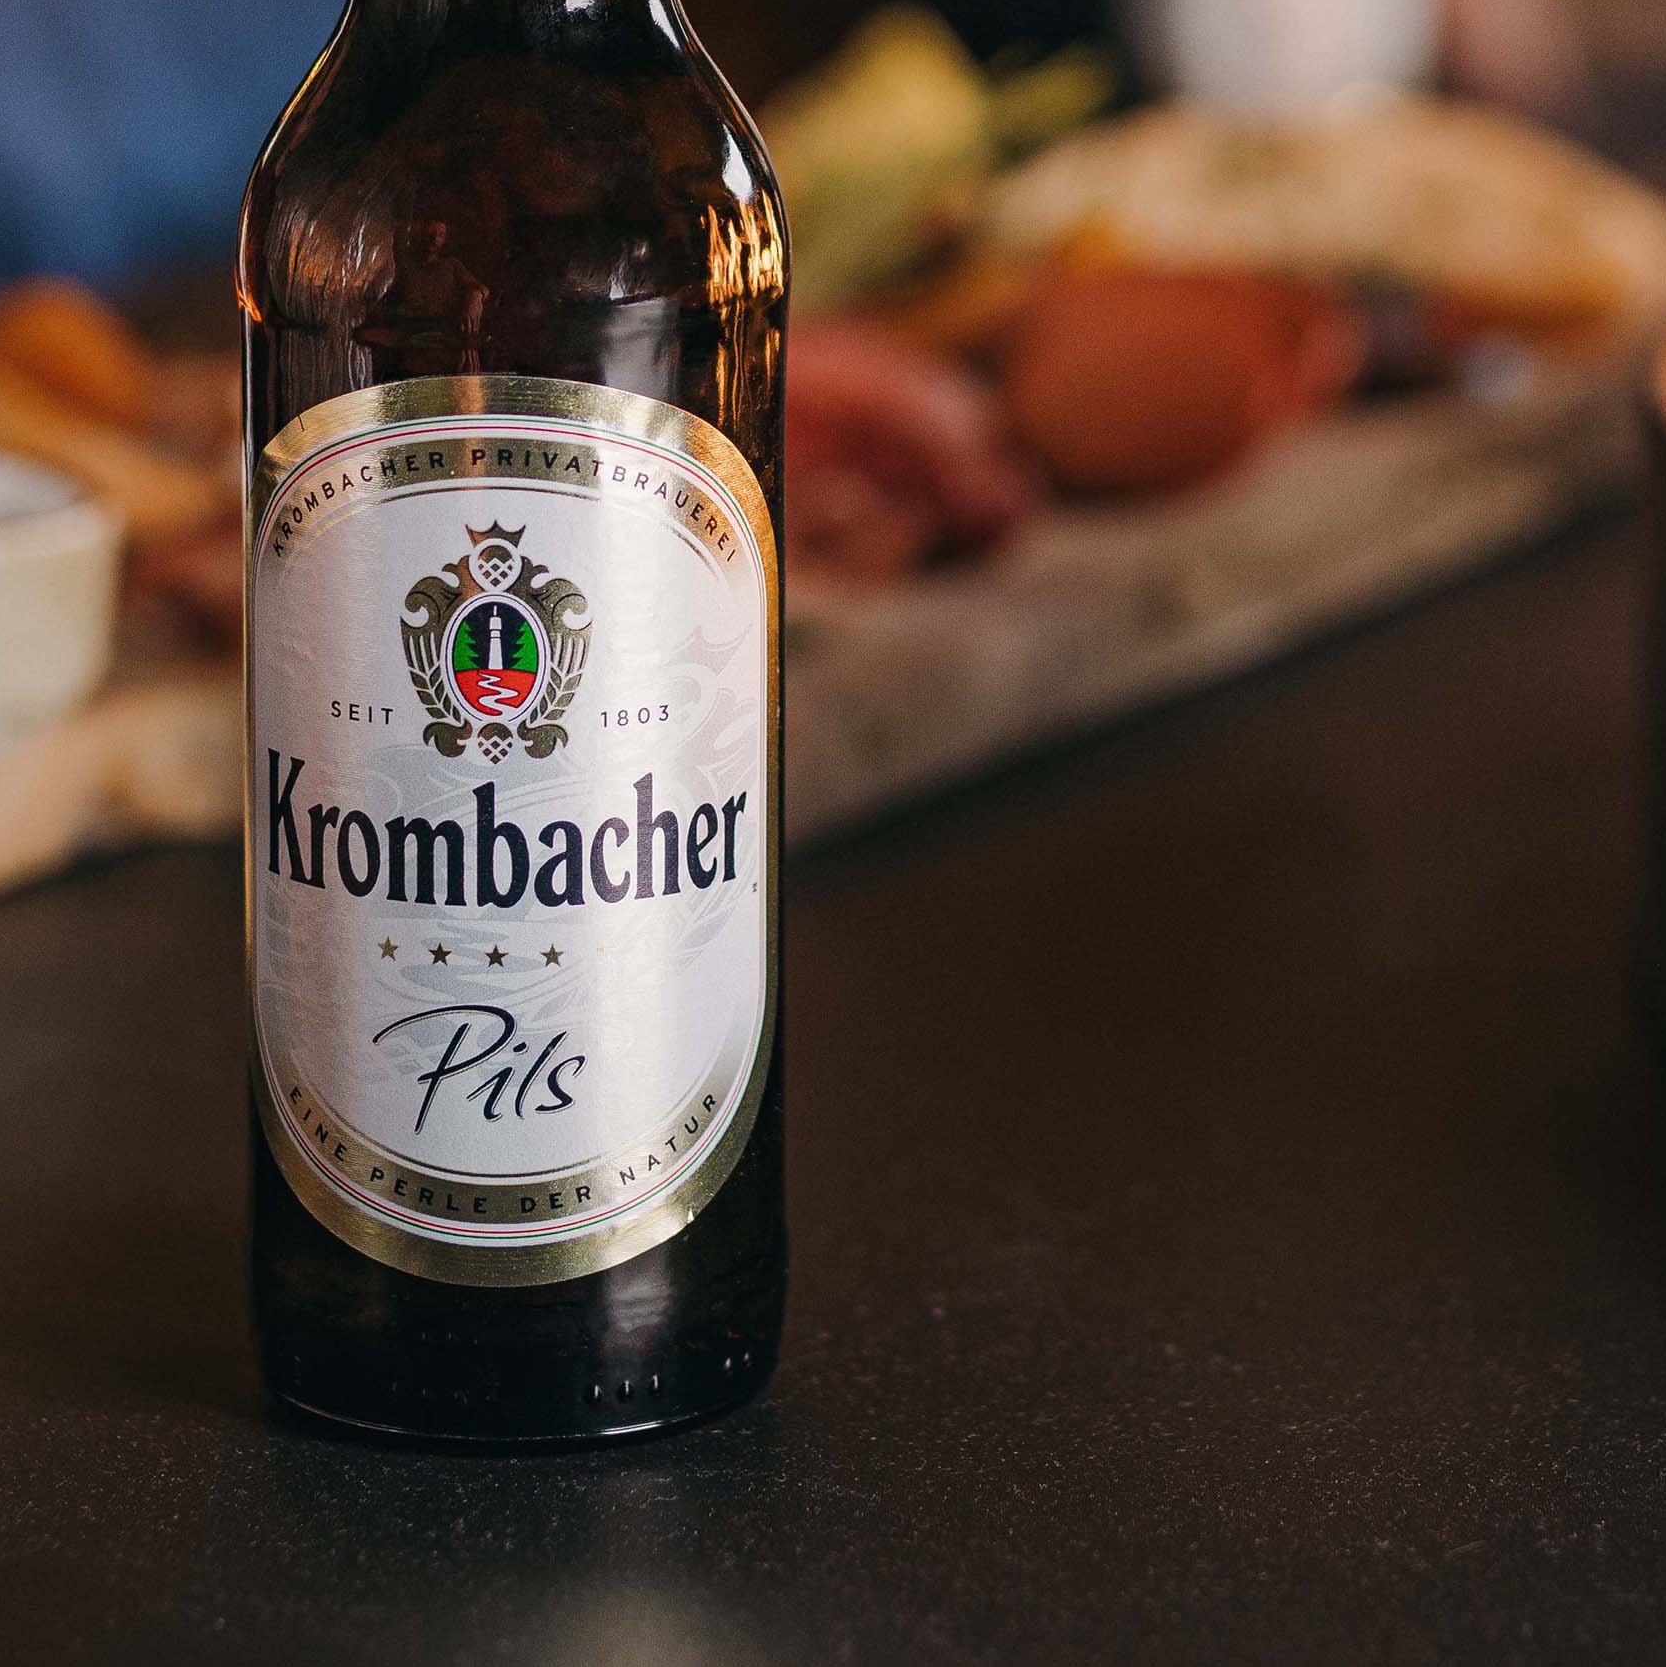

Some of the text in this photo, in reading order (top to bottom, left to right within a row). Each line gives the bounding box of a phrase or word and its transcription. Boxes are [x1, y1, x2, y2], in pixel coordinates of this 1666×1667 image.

[272, 448, 735, 562] KROMBACHER PRIVATBRAUEREI
[330, 700, 670, 729] SEIT 1803
[268, 749, 748, 908] Krombacher
[374, 1005, 587, 1133] Pils
[289, 1087, 717, 1214] EINE PERLE DER NATUR
